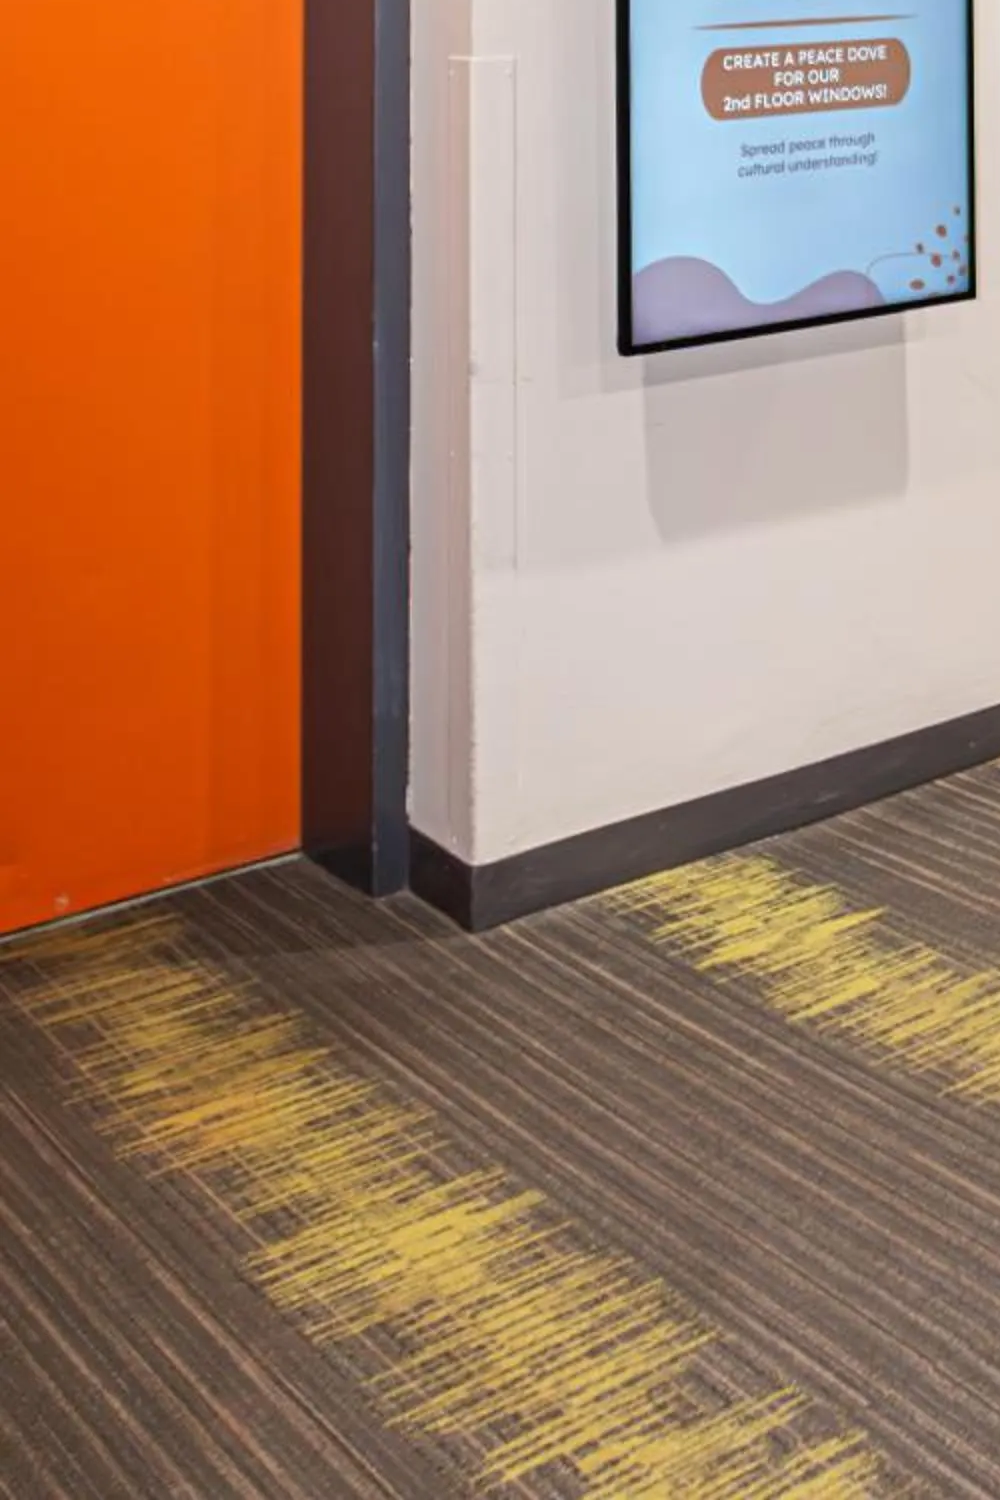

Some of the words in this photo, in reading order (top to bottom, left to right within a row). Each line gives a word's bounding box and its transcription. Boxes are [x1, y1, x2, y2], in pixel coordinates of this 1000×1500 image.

[723, 52, 779, 71] CREATE
[783, 52, 796, 67] A
[799, 49, 844, 64] PEACE
[847, 45, 887, 61] DOVE
[774, 71, 804, 87] FOR
[808, 68, 840, 84] OUR
[723, 95, 751, 112] 2nd
[754, 92, 804, 109] FLOOR
[808, 84, 888, 104] WINDOWS!
[740, 141, 785, 158] Spread
[789, 138, 825, 154] peace
[829, 131, 875, 149] through
[737, 161, 785, 178] cultural
[788, 151, 878, 173] understanding!
